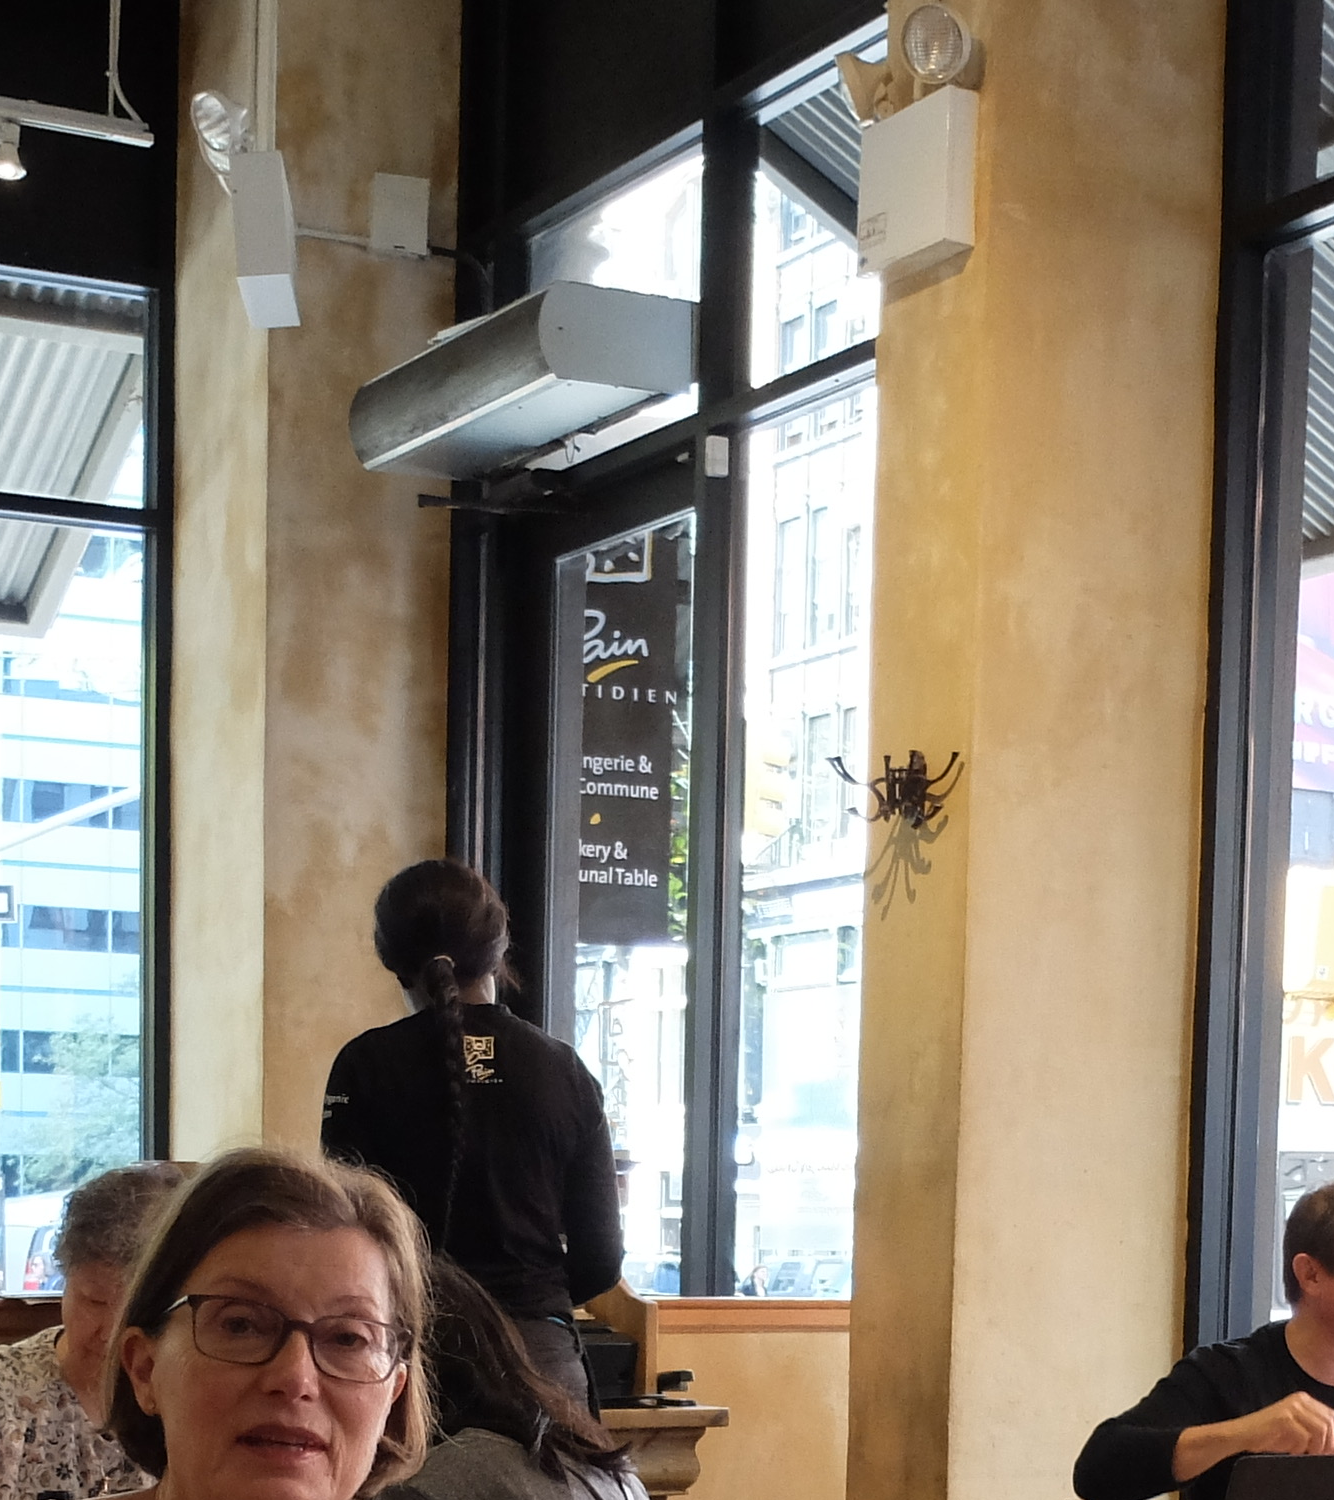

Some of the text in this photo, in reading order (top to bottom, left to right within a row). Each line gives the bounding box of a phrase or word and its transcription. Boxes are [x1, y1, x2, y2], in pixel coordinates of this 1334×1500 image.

[582, 683, 678, 705] TIDIEN
[582, 755, 653, 775] ngerie &
[578, 838, 628, 864] kery &
[615, 868, 659, 887] Table
